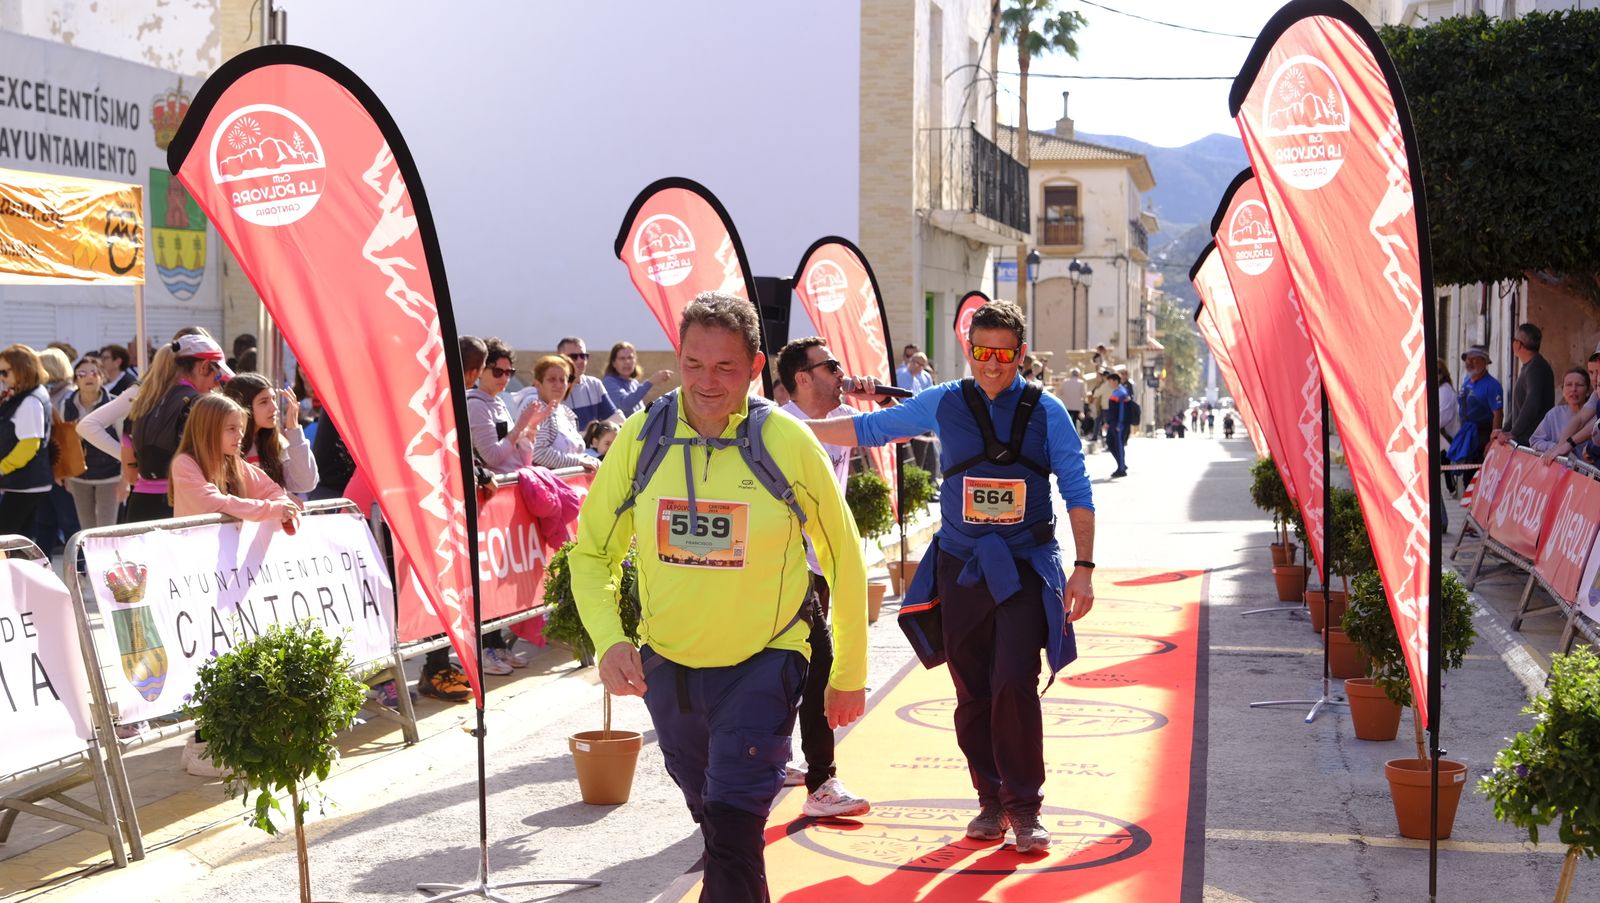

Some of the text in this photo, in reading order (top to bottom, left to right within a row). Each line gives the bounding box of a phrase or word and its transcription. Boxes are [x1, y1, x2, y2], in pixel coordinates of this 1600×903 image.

[0, 127, 136, 175] AYUNTAMIENTO
[973, 489, 1014, 505] 664
[1508, 485, 1548, 532] VEOLIA
[671, 514, 730, 538] 569
[168, 550, 368, 600] AYUNTAMIENTO DE
[478, 522, 546, 582] EOLIA
[0, 612, 36, 643] DE
[176, 579, 380, 659] CANTORIA
